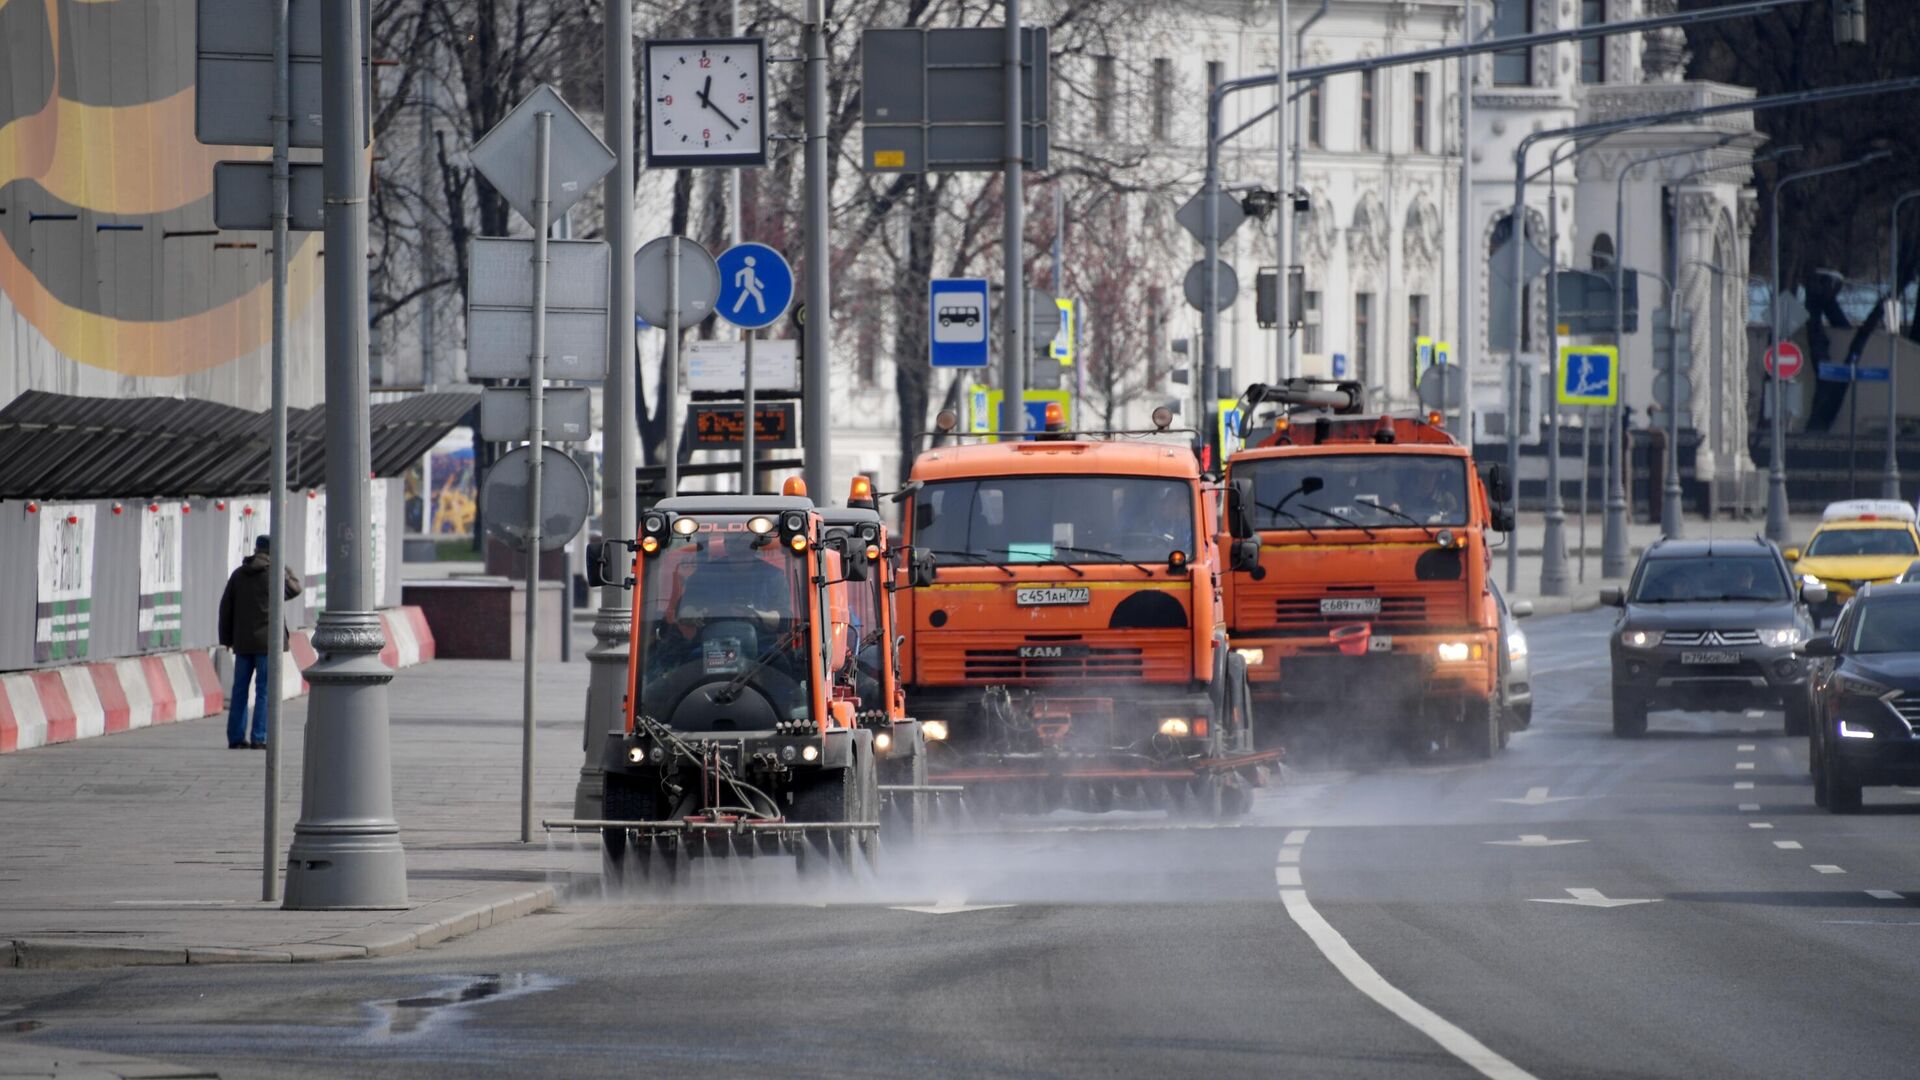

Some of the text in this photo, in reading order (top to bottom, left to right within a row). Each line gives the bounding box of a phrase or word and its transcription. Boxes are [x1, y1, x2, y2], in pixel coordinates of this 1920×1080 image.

[699, 58, 711, 69] 12
[665, 95, 673, 106] 9
[738, 93, 746, 104] 3
[703, 129, 710, 139] 6
[699, 522, 749, 532] OLD
[1020, 590, 1067, 602] С451АН
